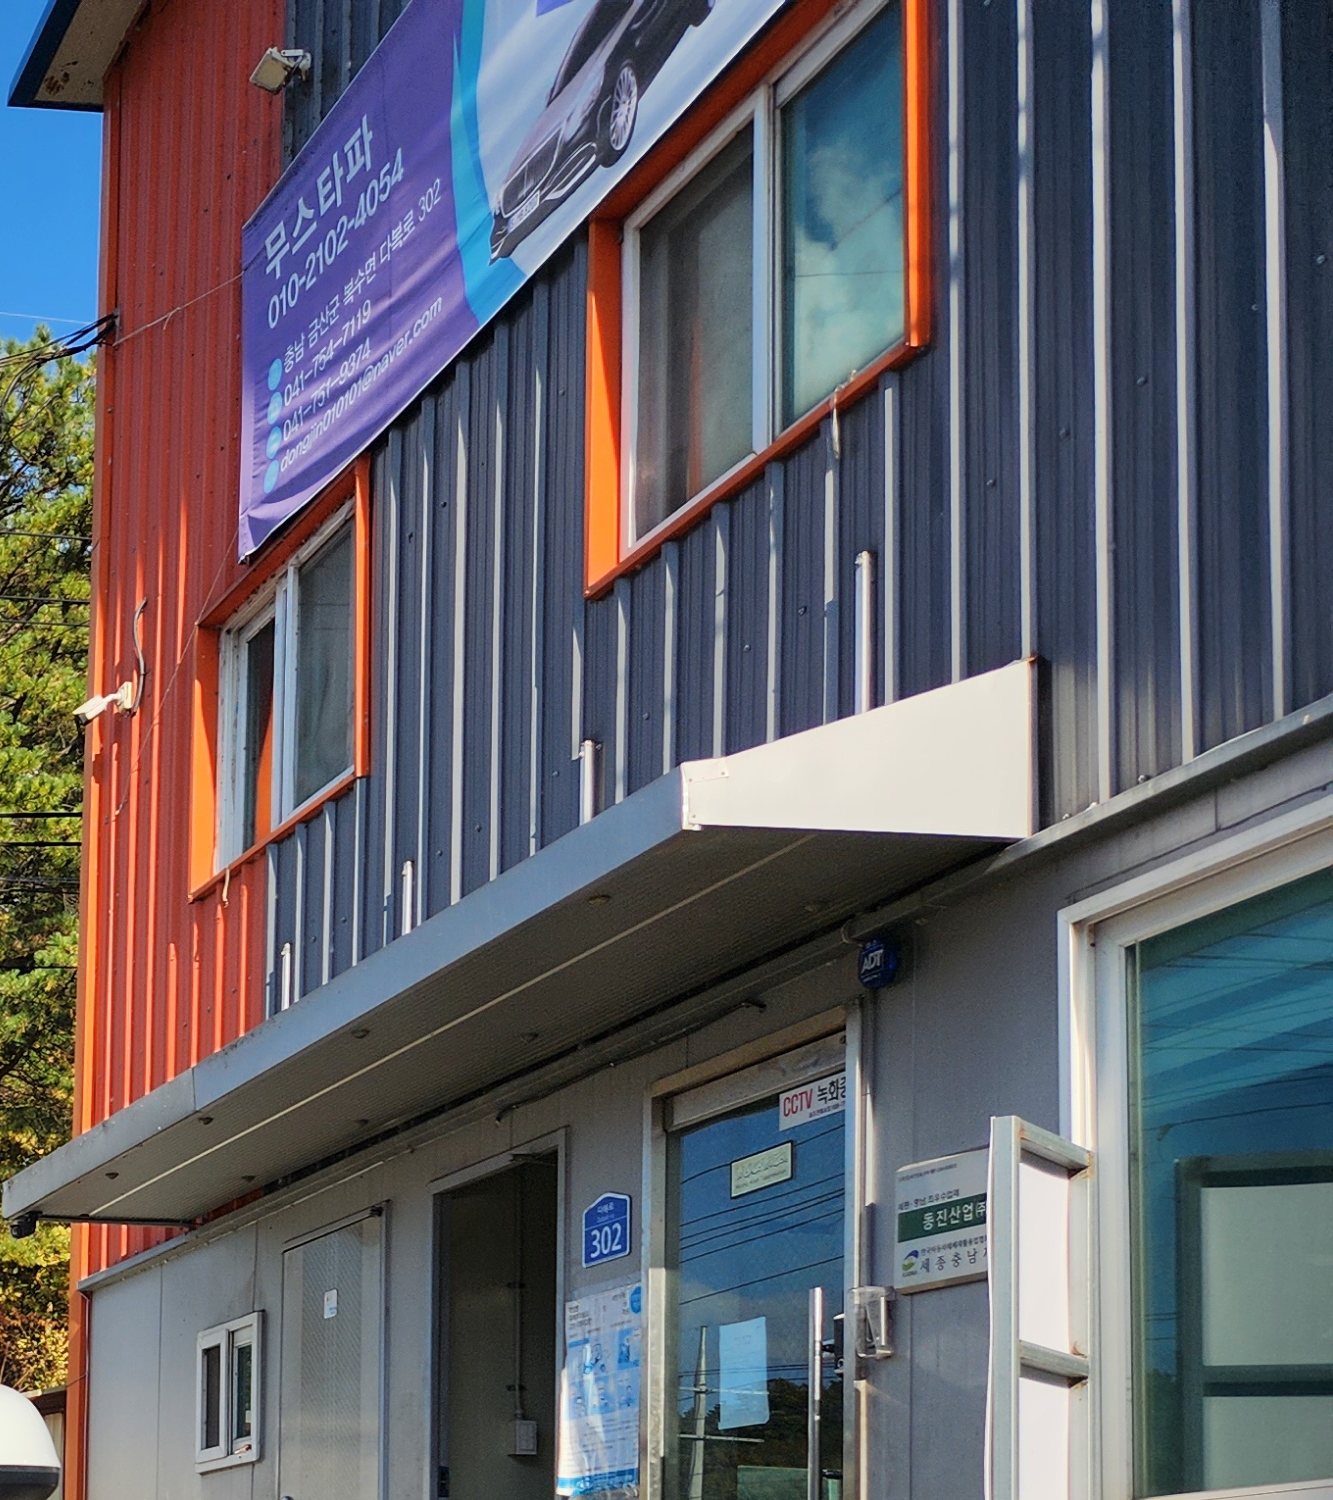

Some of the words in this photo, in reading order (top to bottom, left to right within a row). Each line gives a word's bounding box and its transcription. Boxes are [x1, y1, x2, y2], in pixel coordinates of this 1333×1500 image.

[265, 114, 373, 280] 무스타파
[268, 147, 404, 329] 010-2102-4054
[284, 332, 306, 374] 충남
[308, 294, 340, 349] 금산군
[343, 251, 376, 306] 복수면
[379, 209, 416, 264] 다복로
[418, 178, 441, 222] 302
[283, 337, 371, 442] 041-751-9374
[284, 299, 372, 407] 041-754-7119
[783, 1088, 813, 1117] CCTV
[590, 1222, 622, 1259] 302
